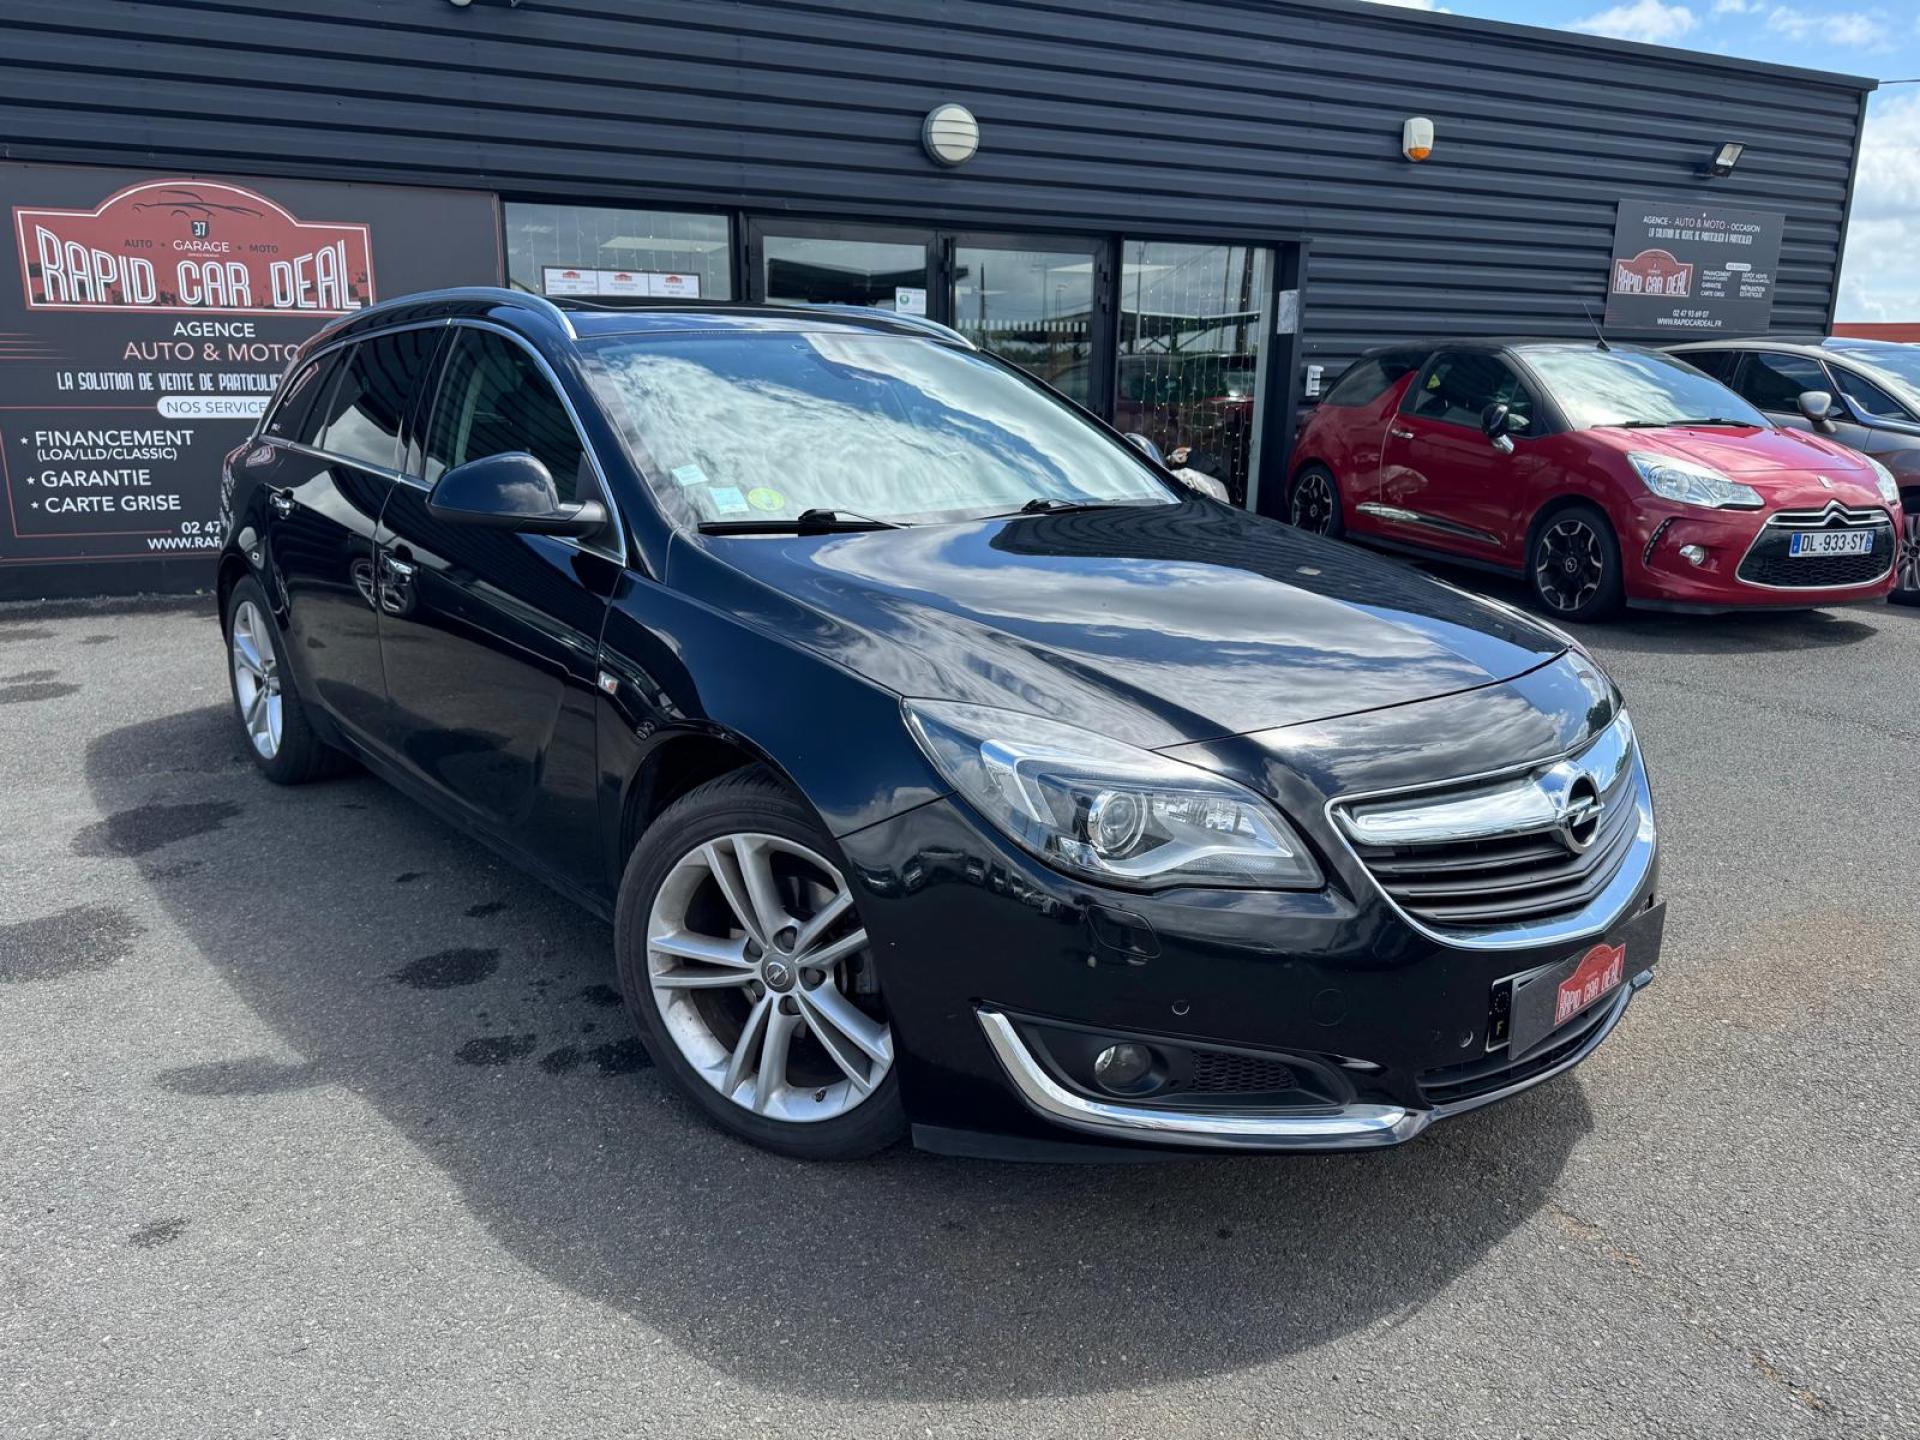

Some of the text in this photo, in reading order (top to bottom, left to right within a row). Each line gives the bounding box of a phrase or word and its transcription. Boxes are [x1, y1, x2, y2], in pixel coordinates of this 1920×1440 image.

[193, 221, 207, 236] 37
[1643, 215, 1669, 225] AGENCE
[1674, 217, 1695, 228] AUTO
[1703, 219, 1726, 229] MOTO
[1730, 222, 1761, 233] OCCASION
[124, 239, 279, 254] AUTO GARAGE MOTO
[35, 224, 362, 309] RAPID CAR DEAL
[1617, 264, 1687, 295] RAPID CAR DEAL
[173, 321, 256, 338] AGENCE
[1656, 317, 1722, 327] WWW.RAPIDCARDEAL.FR
[124, 342, 300, 361] AUTO & MOTO
[57, 372, 283, 392] LA SOLUTION DE VENTE DE PARTICULIE
[166, 401, 201, 414] NOS
[35, 430, 195, 447] FINANCEMENT
[37, 448, 178, 462] (LOA/LLD/CLASSIC)
[41, 469, 152, 488] GARANTIE
[45, 494, 182, 513] CARTE GRISE
[181, 521, 222, 535] 02 47
[1802, 533, 1865, 552] DL-933-SY
[1558, 951, 1620, 1020] RAPID CAR DEAL
[1496, 1021, 1503, 1033] F
